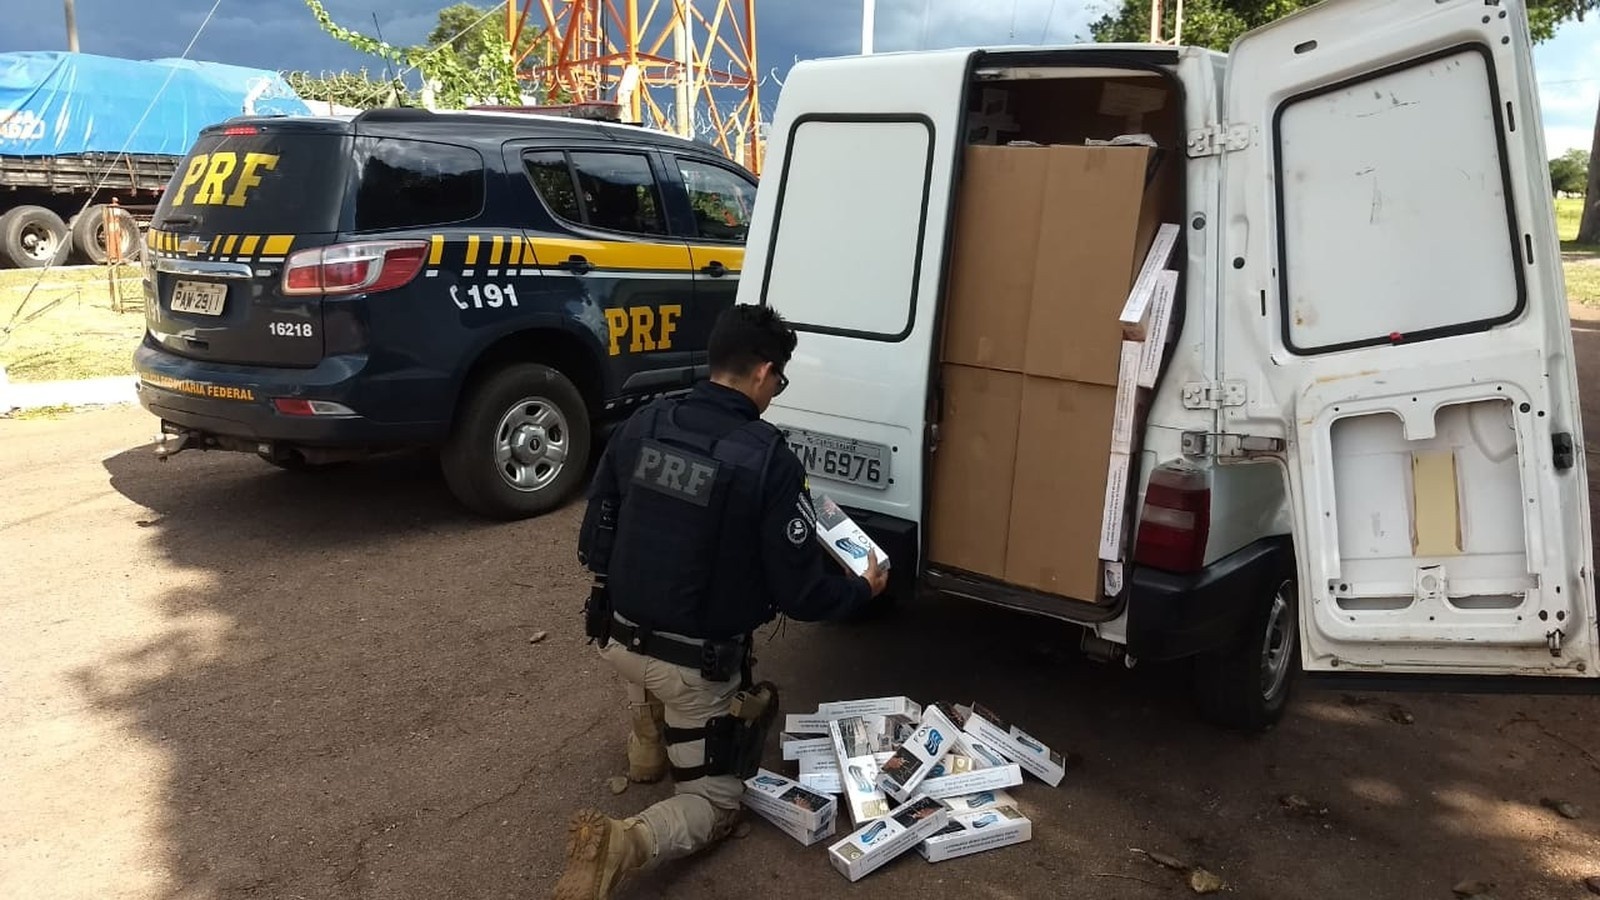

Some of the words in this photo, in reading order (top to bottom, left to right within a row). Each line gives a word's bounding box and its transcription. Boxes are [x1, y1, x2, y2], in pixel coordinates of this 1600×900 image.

[172, 151, 280, 207] PRF
[467, 283, 519, 309] 191
[269, 322, 312, 337] 16218
[605, 304, 681, 356] PRF
[207, 385, 255, 400] FEDERAL
[634, 445, 715, 497] PRF
